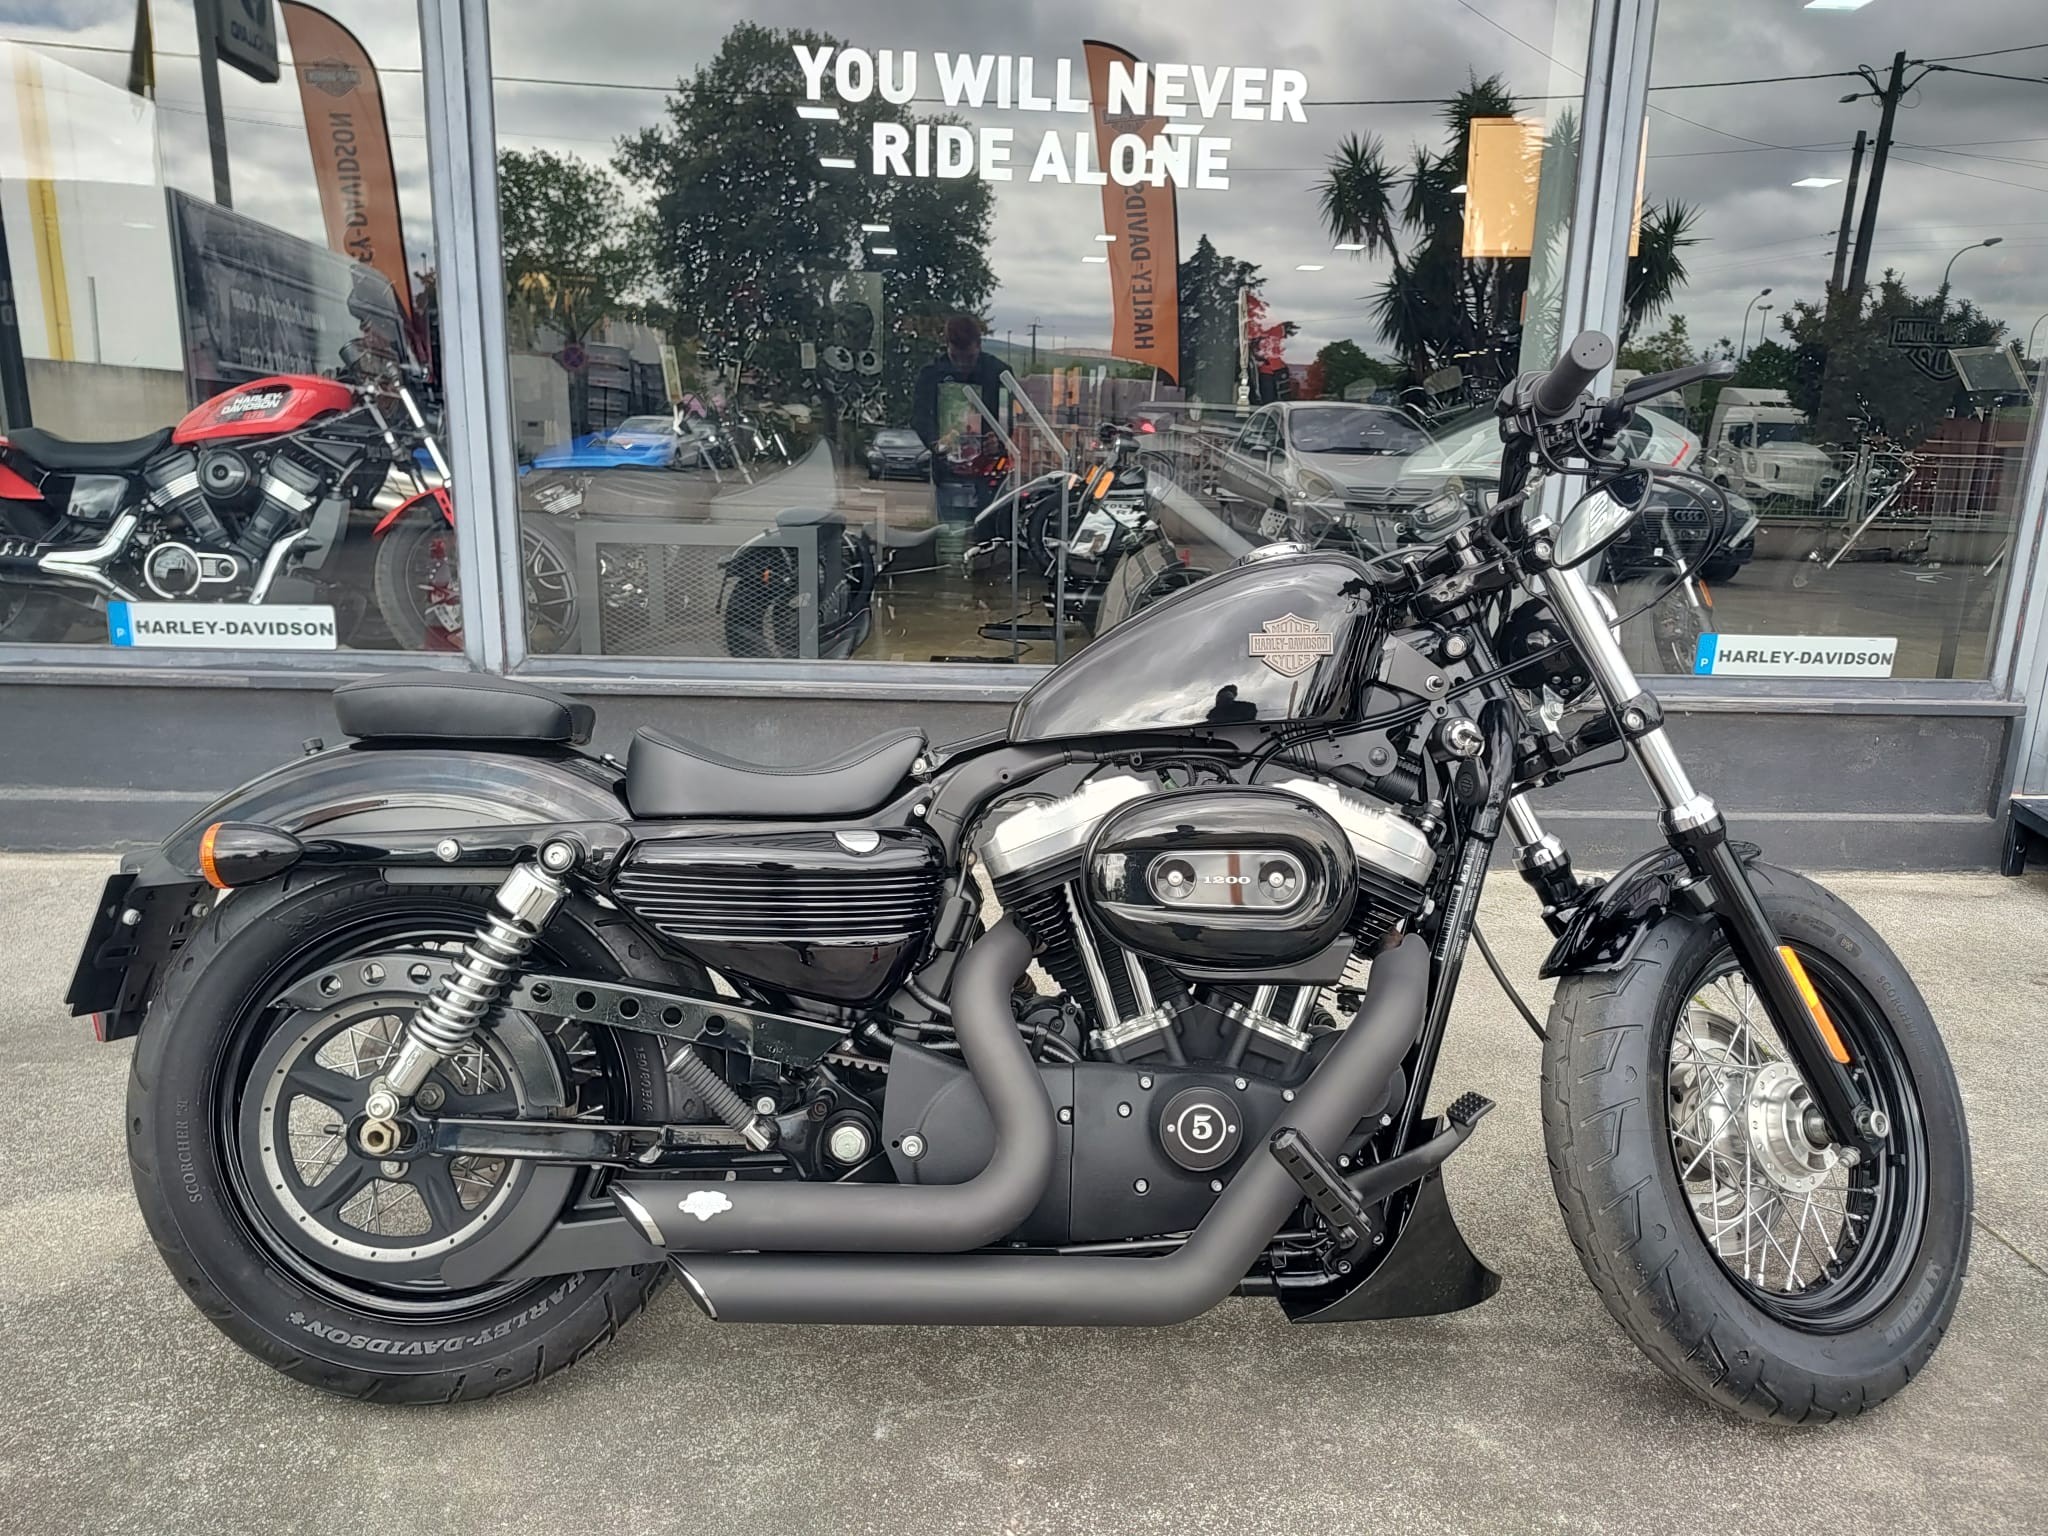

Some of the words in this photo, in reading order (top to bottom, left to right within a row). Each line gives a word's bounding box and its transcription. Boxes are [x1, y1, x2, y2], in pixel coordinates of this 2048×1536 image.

[792, 45, 917, 104] YOU
[934, 52, 1089, 113] WILL
[1108, 61, 1308, 122] NEVER
[873, 122, 1013, 181] RIDE
[1029, 130, 1232, 190] ALONE
[221, 400, 281, 415] DAVIDSON
[116, 627, 126, 639] P
[135, 620, 334, 637] HARLEY-DAVIDSON
[1271, 621, 1311, 633] MOTOR
[1254, 636, 1328, 651] HARLEY-DAVIDSON
[1271, 654, 1311, 669] CYCLES
[1700, 657, 1709, 667] P
[1718, 648, 1893, 667] HARLEY-DAVIDSON
[1203, 874, 1251, 886] 1200
[1192, 1115, 1213, 1141] 5
[175, 1120, 203, 1204] SCORCHER
[304, 1271, 586, 1356] HARLEY-DAVIDSON
